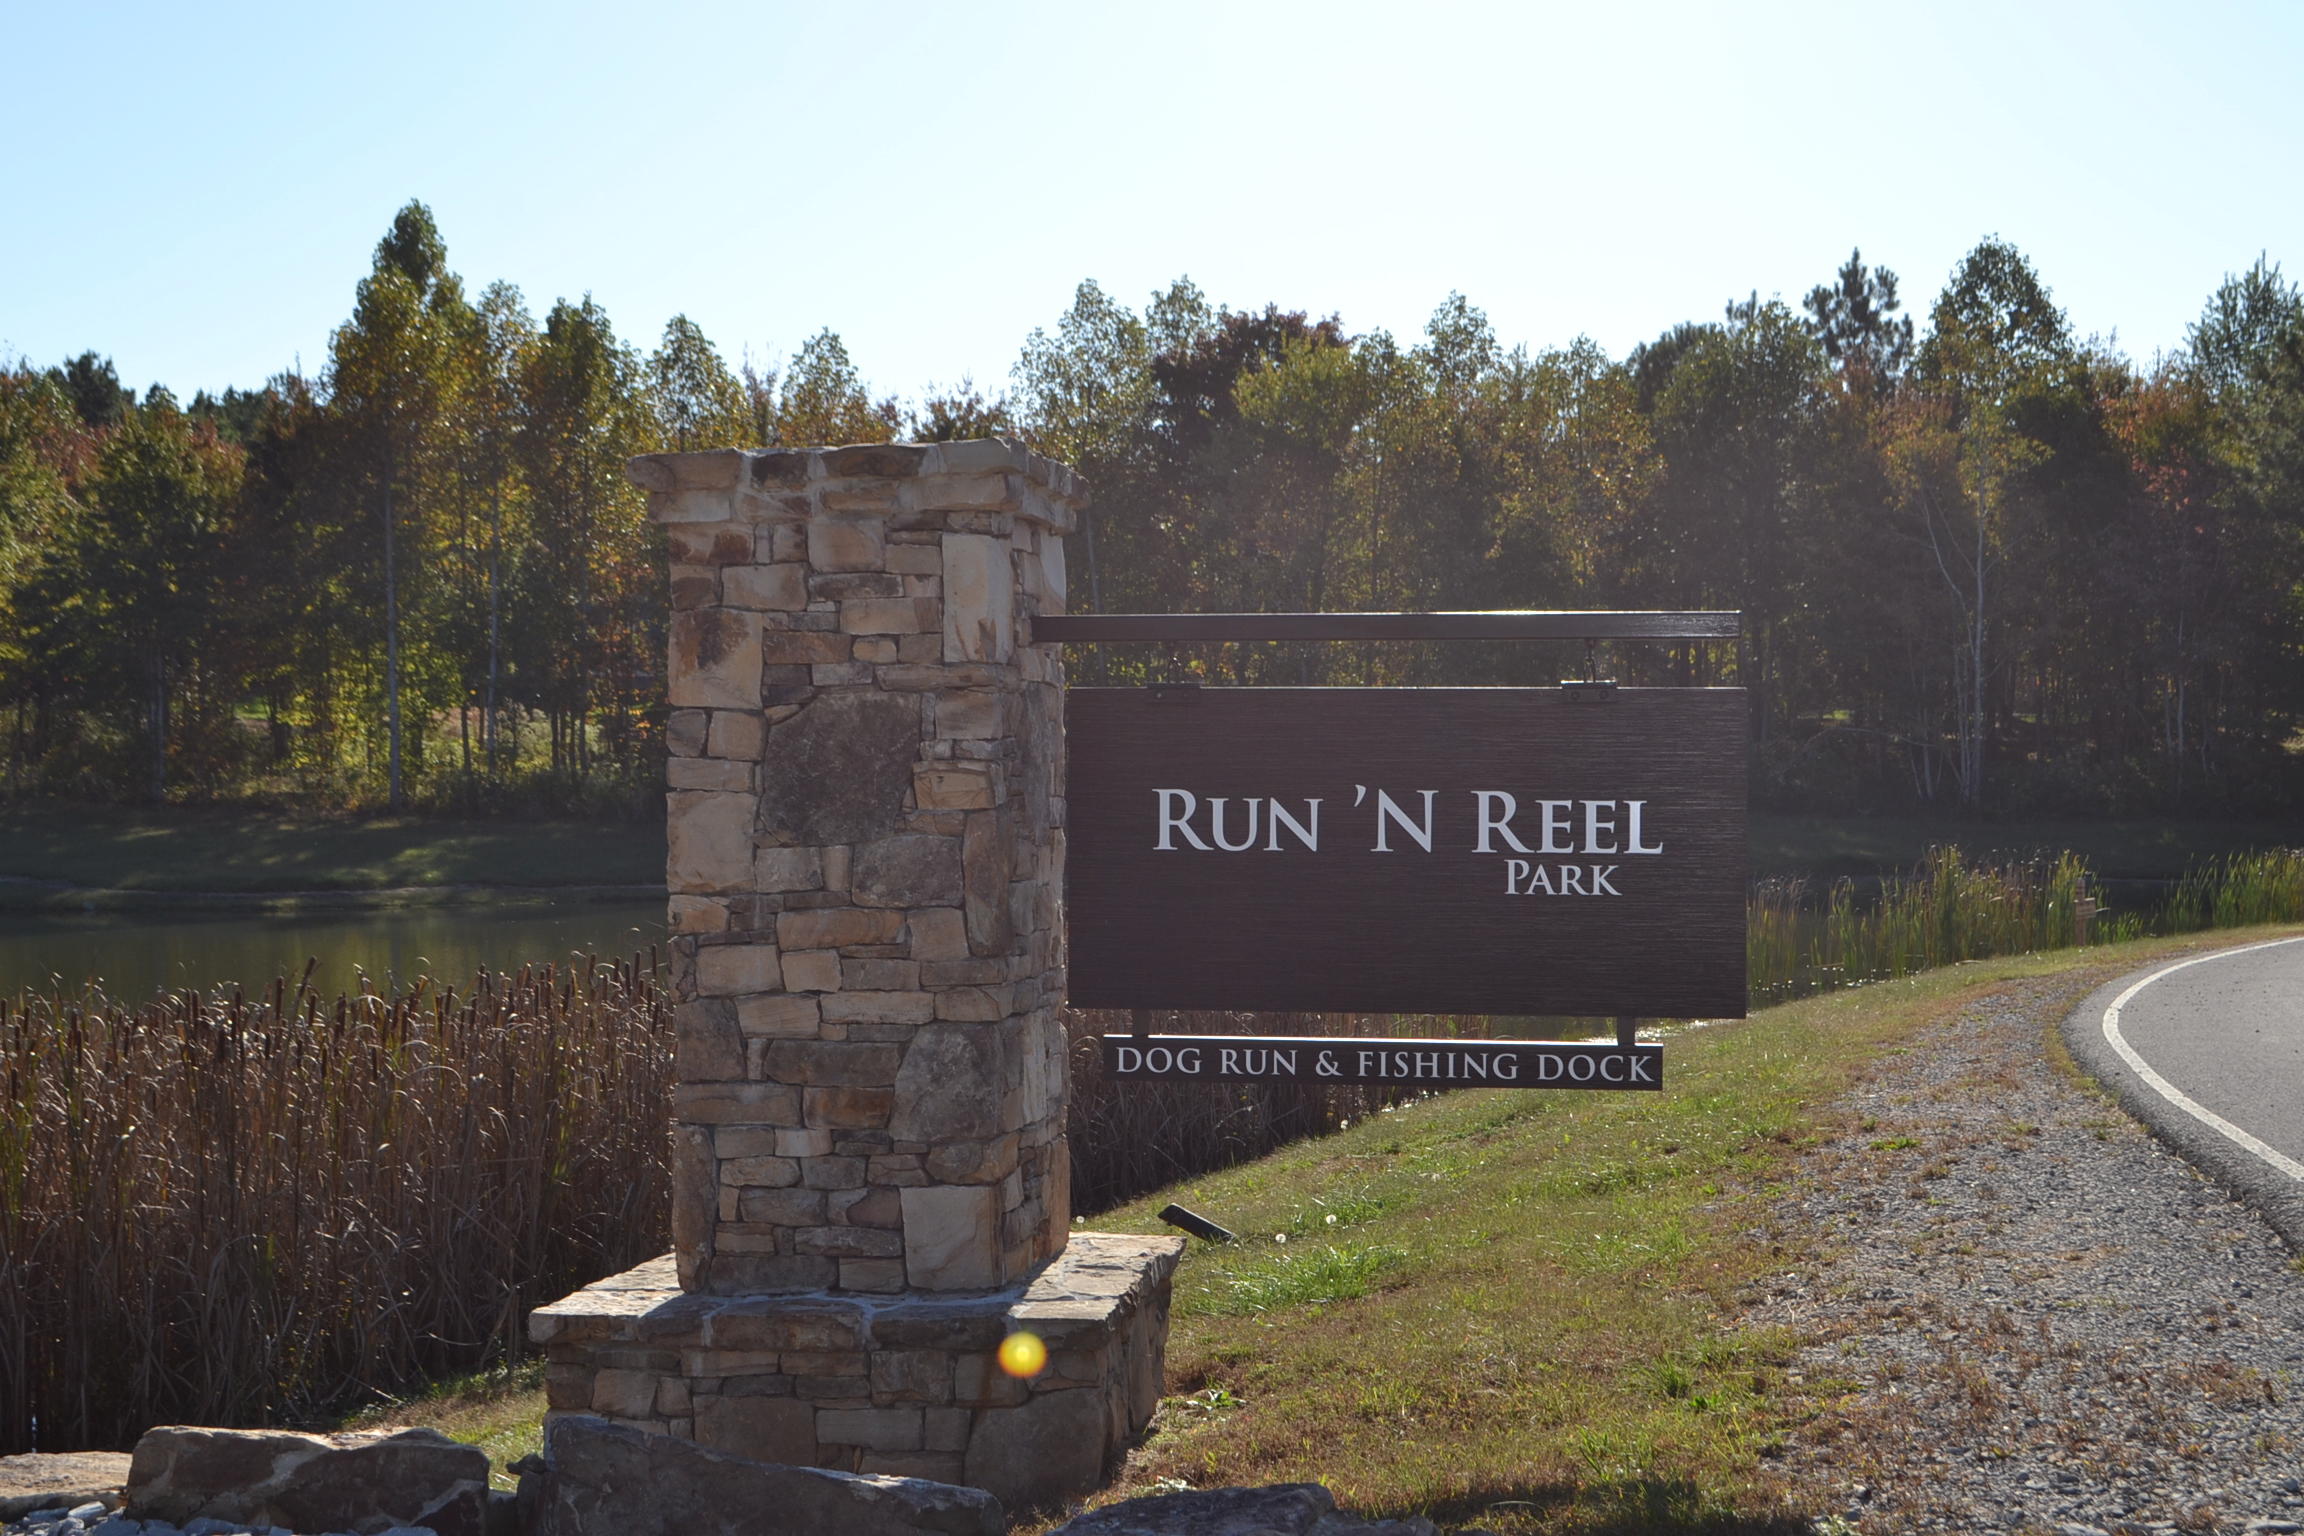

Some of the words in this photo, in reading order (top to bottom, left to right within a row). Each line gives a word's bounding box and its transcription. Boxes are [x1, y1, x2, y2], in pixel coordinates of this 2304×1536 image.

[1152, 788, 1324, 852] RUN
[1470, 790, 1664, 855] REEL
[1503, 859, 1622, 896] PARK
[1116, 1047, 1201, 1074] DOG
[1219, 1049, 1298, 1075] RUN
[1315, 1050, 1343, 1077] &
[1358, 1051, 1519, 1080] FISHING
[1537, 1054, 1654, 1082] DOCK
